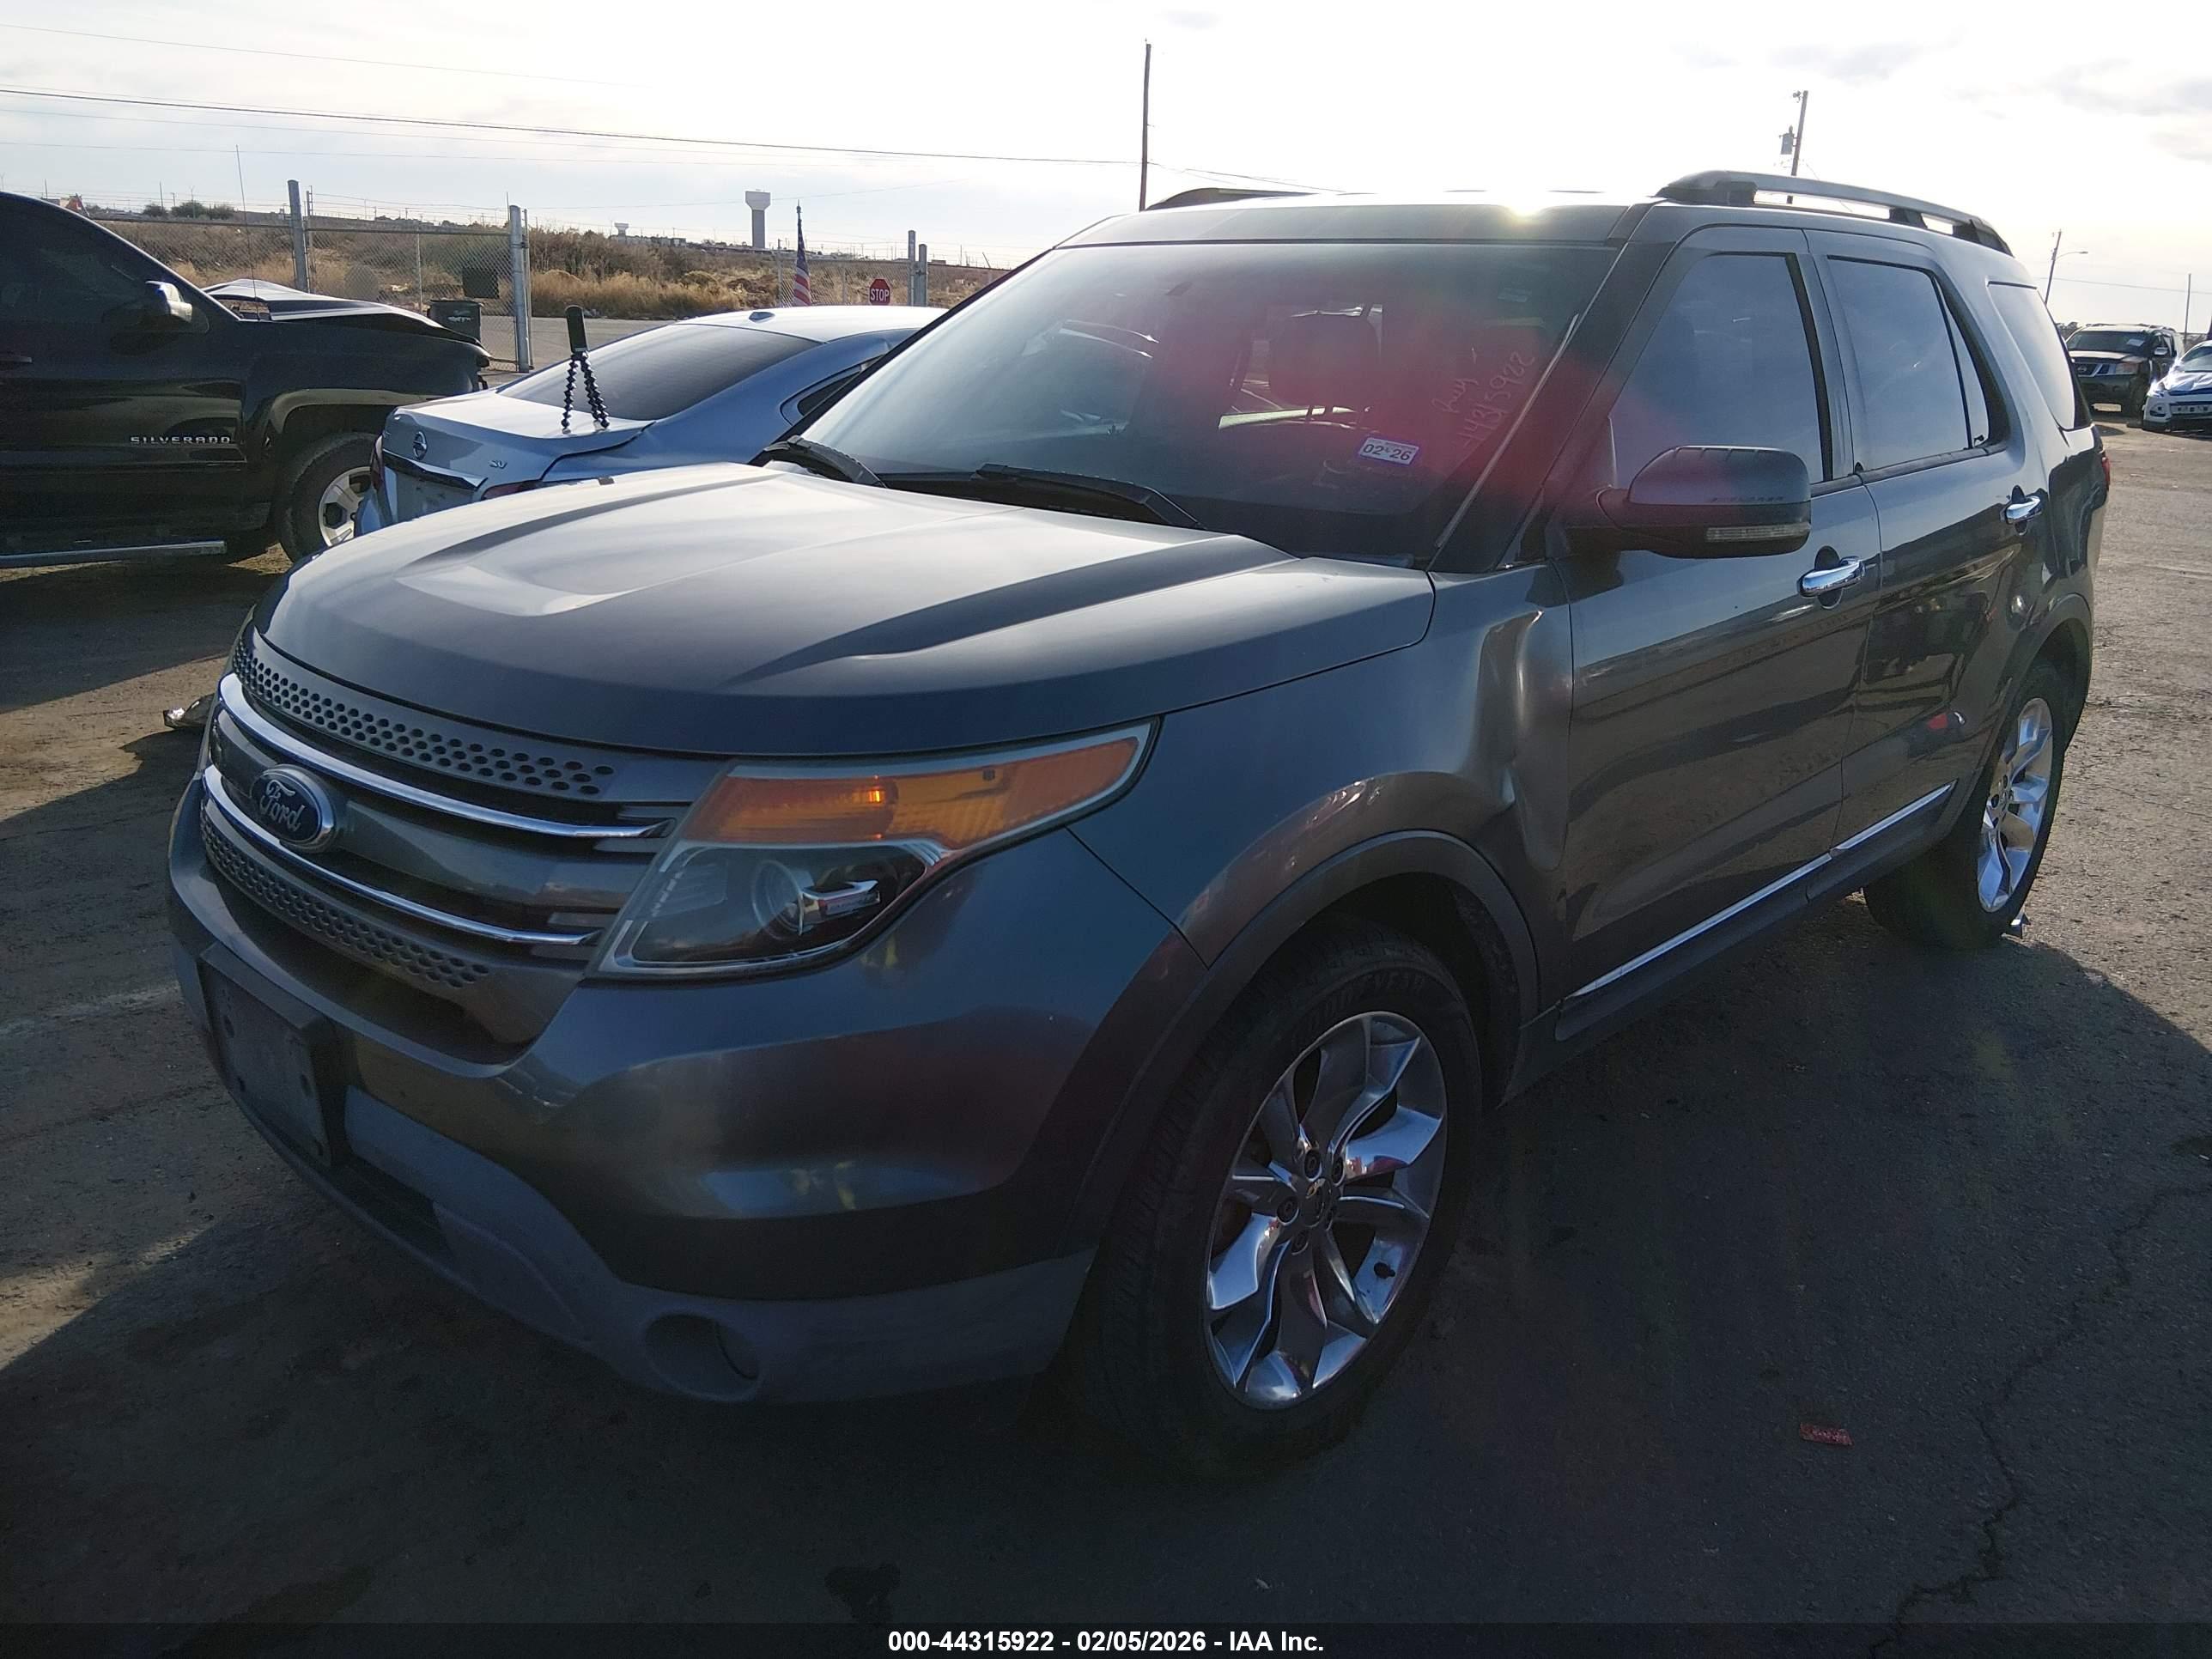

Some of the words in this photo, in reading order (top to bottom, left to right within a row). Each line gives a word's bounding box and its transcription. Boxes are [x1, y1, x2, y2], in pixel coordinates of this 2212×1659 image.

[871, 289, 889, 301] STOP
[130, 435, 231, 444] SILVERADO
[259, 779, 306, 832] Ford
